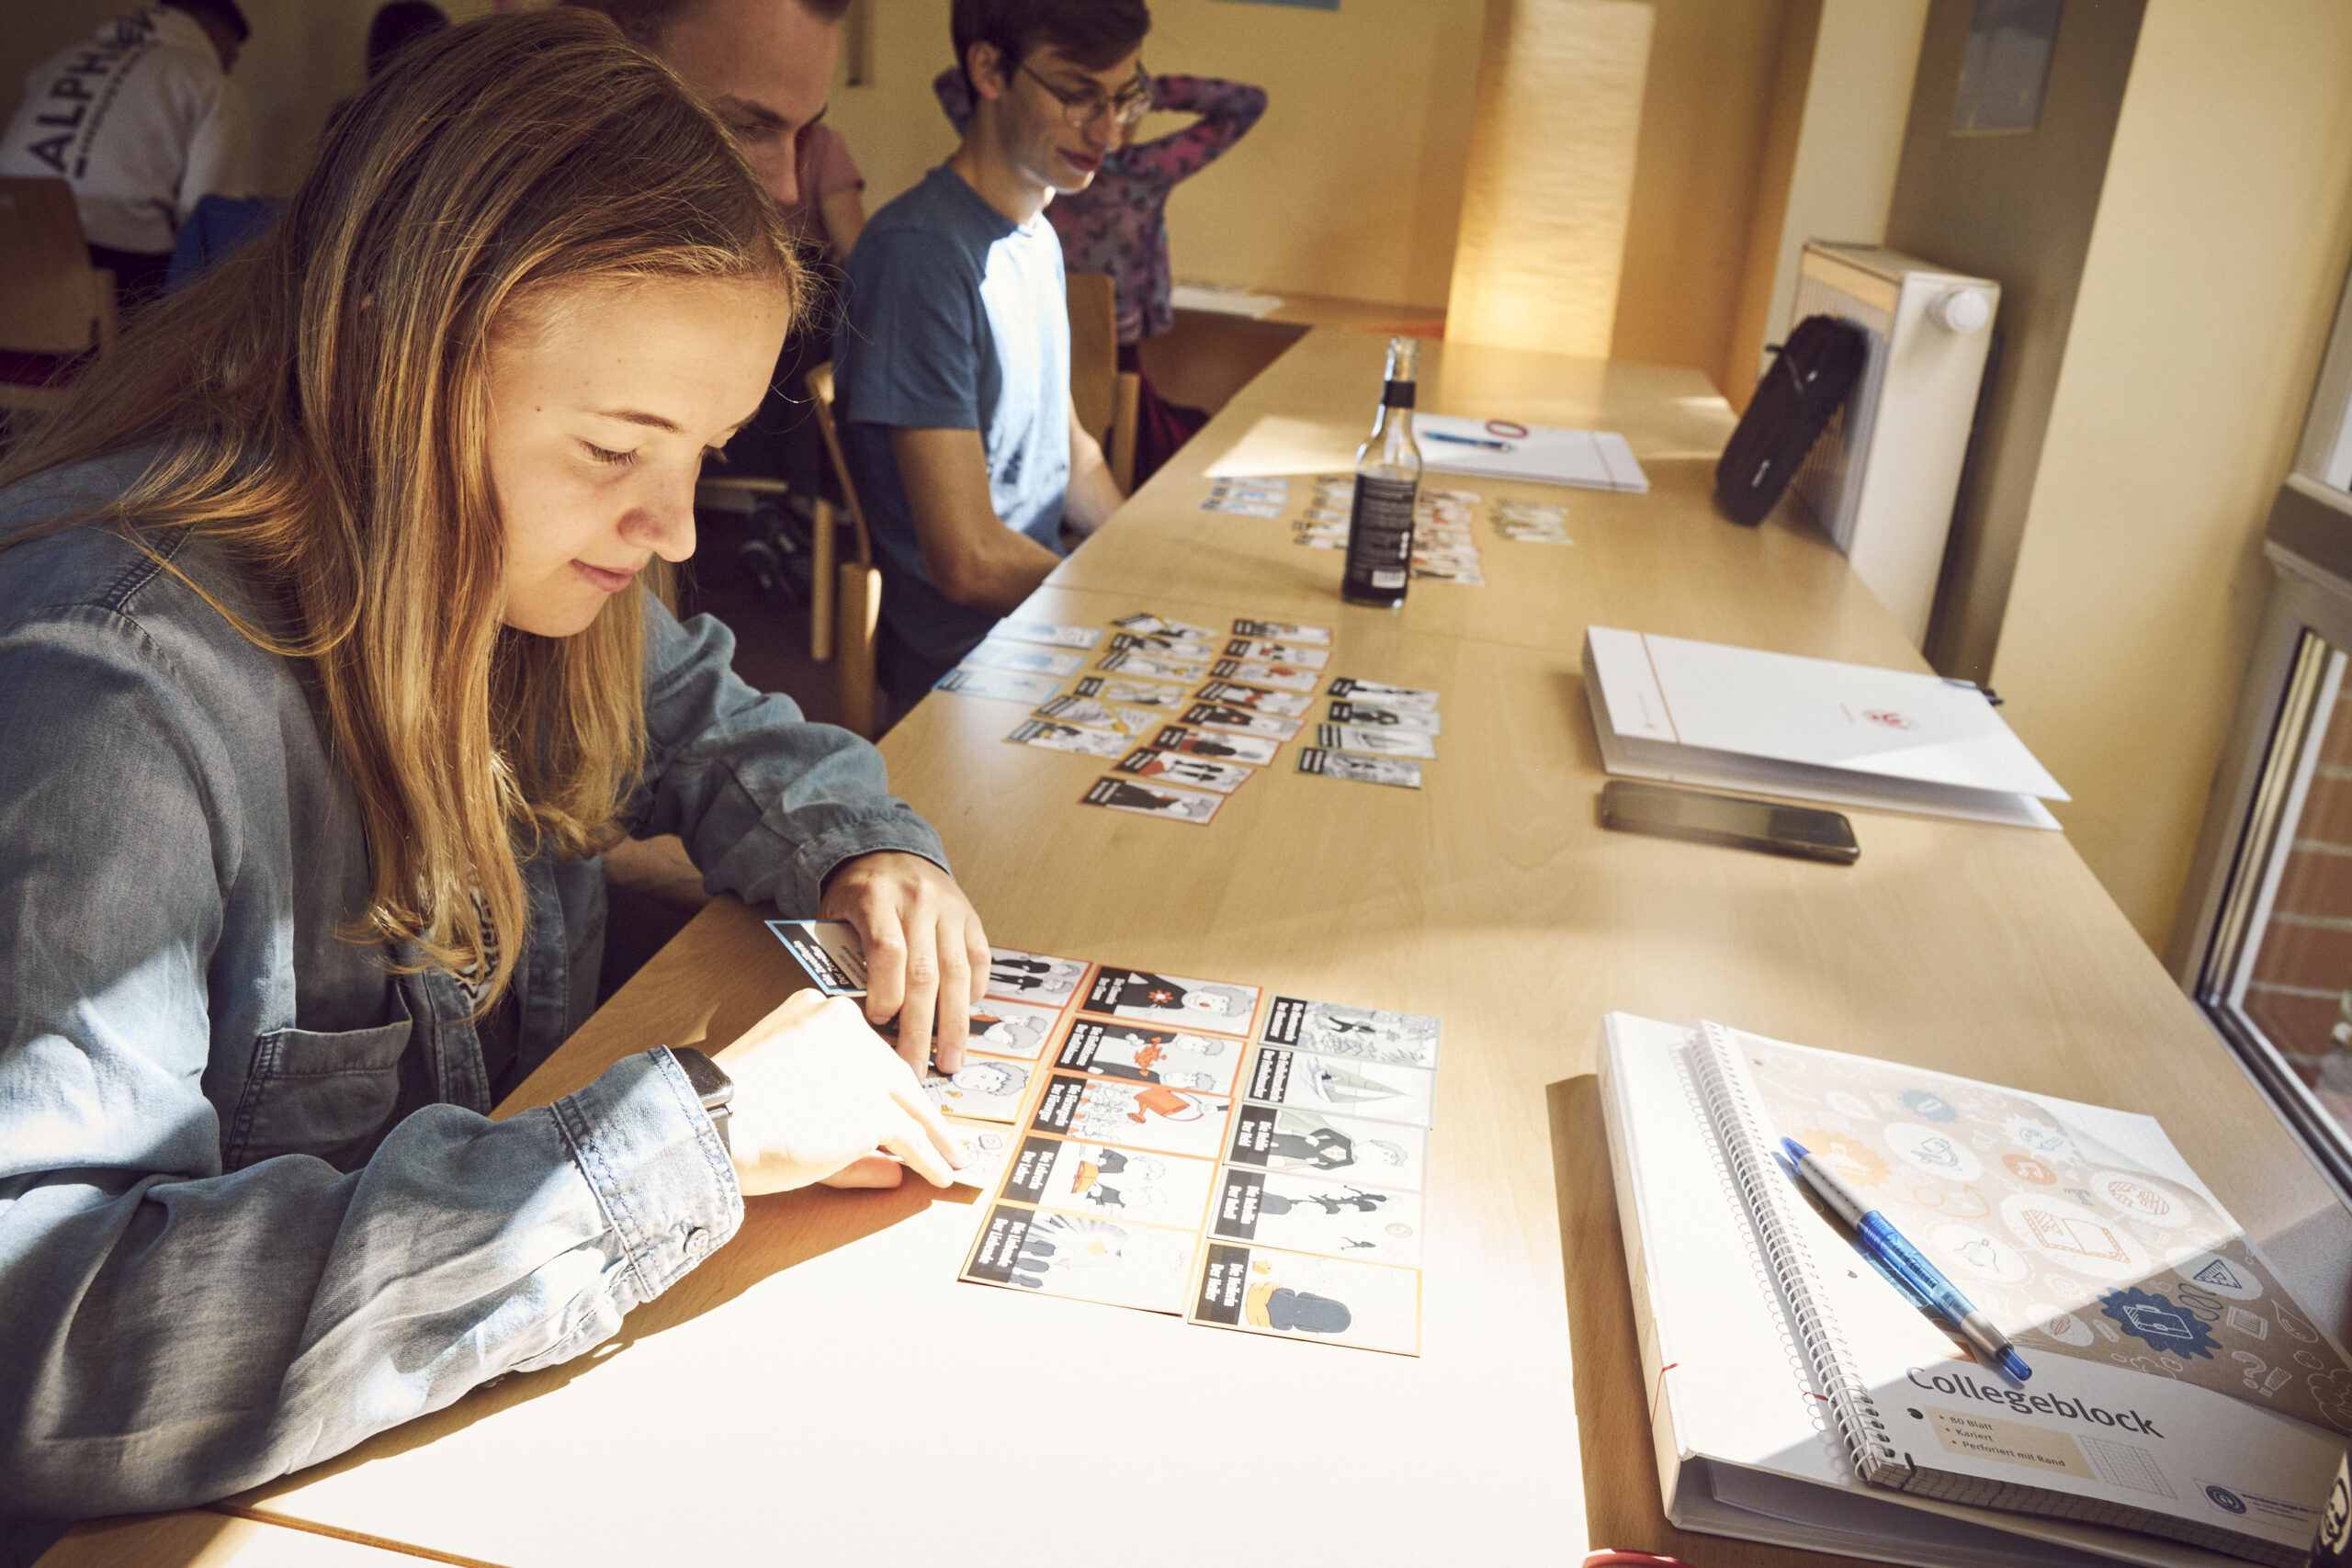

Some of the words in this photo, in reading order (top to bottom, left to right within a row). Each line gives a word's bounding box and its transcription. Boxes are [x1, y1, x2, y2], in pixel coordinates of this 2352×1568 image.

[820, 973, 837, 987] Die
[834, 974, 849, 985] Der
[1051, 1084, 1065, 1095] Der
[1067, 1085, 1081, 1094] Die
[1241, 1121, 1255, 1133] Der
[1259, 1122, 1272, 1132] Die
[1238, 1133, 1252, 1146] Held
[1255, 1132, 1270, 1151] Heldin
[1022, 1151, 1036, 1163] Der
[1039, 1152, 1054, 1163] Die
[1012, 1163, 1031, 1184] Lehrer
[1028, 1163, 1050, 1189] Lehrerin
[1227, 1186, 1241, 1198] Der
[1246, 1186, 1260, 1197] Die
[1223, 1198, 1239, 1219] Rebell
[1240, 1198, 1258, 1224] Rebellin
[992, 1218, 1008, 1232] Der
[1011, 1222, 1025, 1234] Die
[978, 1232, 1002, 1264] Liebende
[997, 1235, 1021, 1267] Liebende
[1210, 1264, 1224, 1278] Der
[1229, 1263, 1243, 1276] Die
[1205, 1278, 1221, 1301] Heiler
[1224, 1277, 1241, 1306] Heilerin
[1906, 1367, 2165, 1438] Collegeblock
[1966, 1418, 1993, 1431] Blatt
[1956, 1429, 1994, 1442] Kariert
[1962, 1440, 2014, 1458] Perforiert
[2017, 1451, 2035, 1461] mit
[2038, 1455, 2065, 1467] Rand
